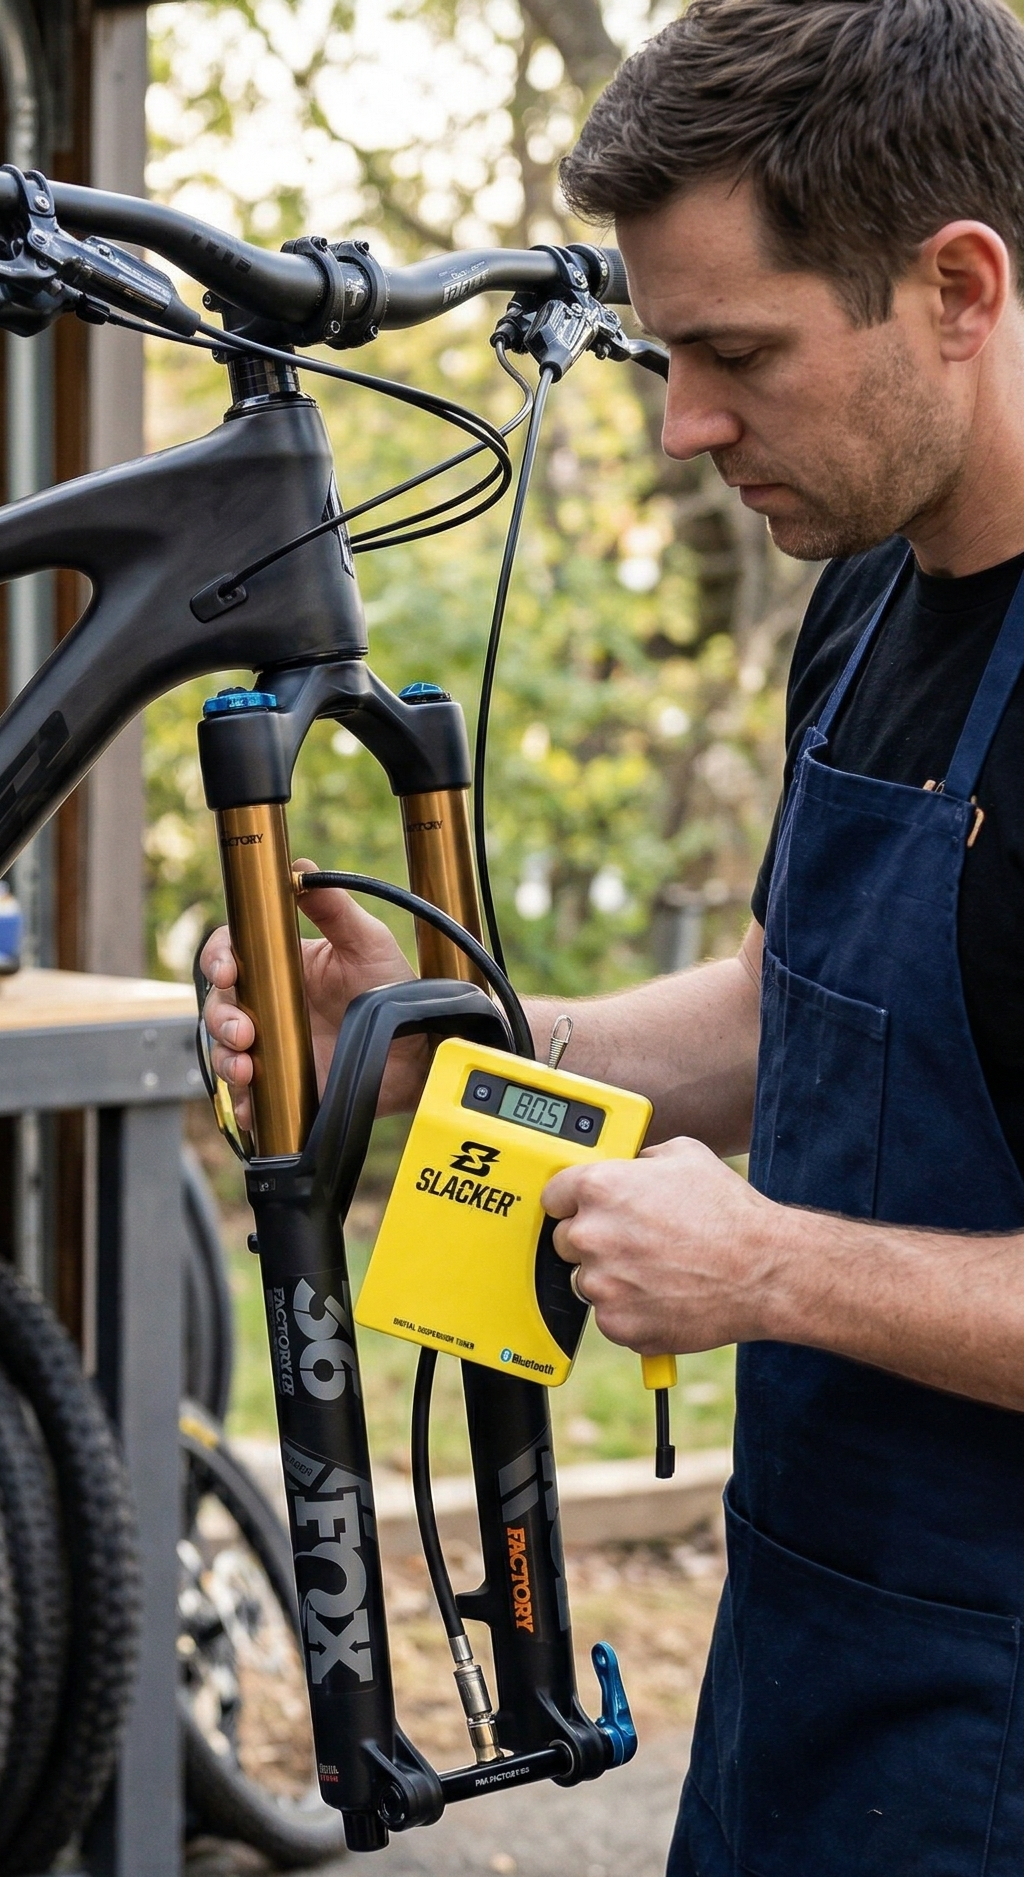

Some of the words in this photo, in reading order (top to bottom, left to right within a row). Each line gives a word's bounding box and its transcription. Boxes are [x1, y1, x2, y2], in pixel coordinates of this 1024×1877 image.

[415, 1167, 517, 1217] SLACKER
[273, 1287, 293, 1377] FACTORY
[293, 1278, 356, 1400] 36
[295, 1492, 374, 1685] FOX
[506, 1527, 534, 1634] FACTORY
